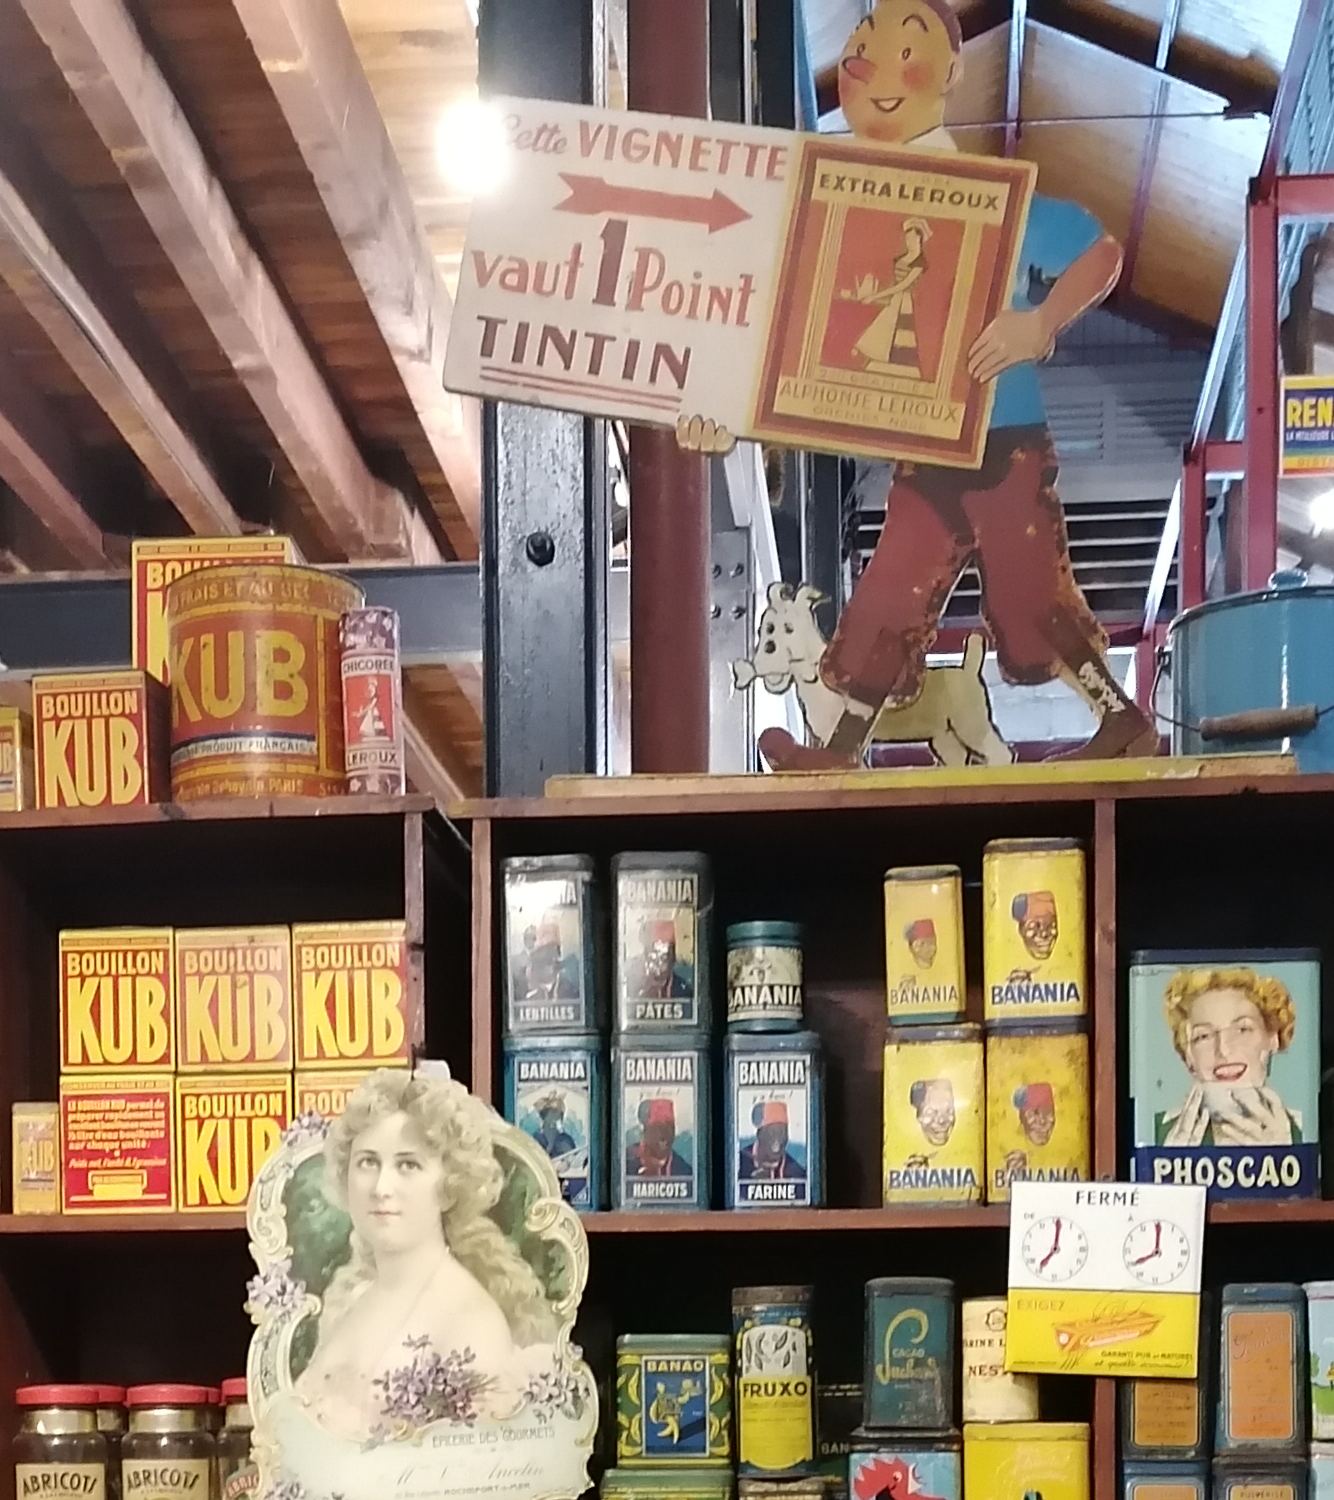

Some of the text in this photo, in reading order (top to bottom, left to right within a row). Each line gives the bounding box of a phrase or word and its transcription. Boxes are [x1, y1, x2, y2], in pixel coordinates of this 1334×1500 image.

[576, 119, 789, 183] VIGNETTE
[471, 218, 756, 328] vaut 1 Point
[476, 314, 692, 390] TINTIN
[878, 395, 959, 424] LEROUX
[342, 658, 396, 674] CHICORÉE
[171, 630, 309, 728] KUB
[42, 690, 138, 718] BOUILLON
[43, 718, 143, 808] KUB
[347, 751, 398, 767] LEROUX
[627, 877, 694, 904] BANANIA
[66, 951, 165, 976] BOUILLON
[184, 947, 283, 974] BOUILLON
[300, 943, 401, 970] BOUILLON
[890, 985, 961, 1007] BANANIA
[990, 981, 1081, 1006] BANANIA
[66, 974, 169, 1064] KUB
[184, 974, 287, 1064] KUB
[302, 970, 406, 1060] KUB
[635, 1001, 684, 1020] PÂTES
[519, 1061, 586, 1081] BANANIA
[625, 1058, 694, 1081] BANANIA
[738, 1061, 807, 1085] BANANIA
[184, 1093, 284, 1119] BOUILLON
[888, 1166, 977, 1190] BANANIA
[994, 1166, 1082, 1189] BANANIA
[1153, 1154, 1301, 1190] PHOSCAO
[632, 1181, 688, 1199] HARICOTS
[747, 1184, 796, 1201] FARINE
[1075, 1188, 1140, 1207] FERMÉ
[646, 1360, 704, 1373] BANAO
[742, 1380, 808, 1398] FRUXO
[479, 1431, 498, 1445] DES
